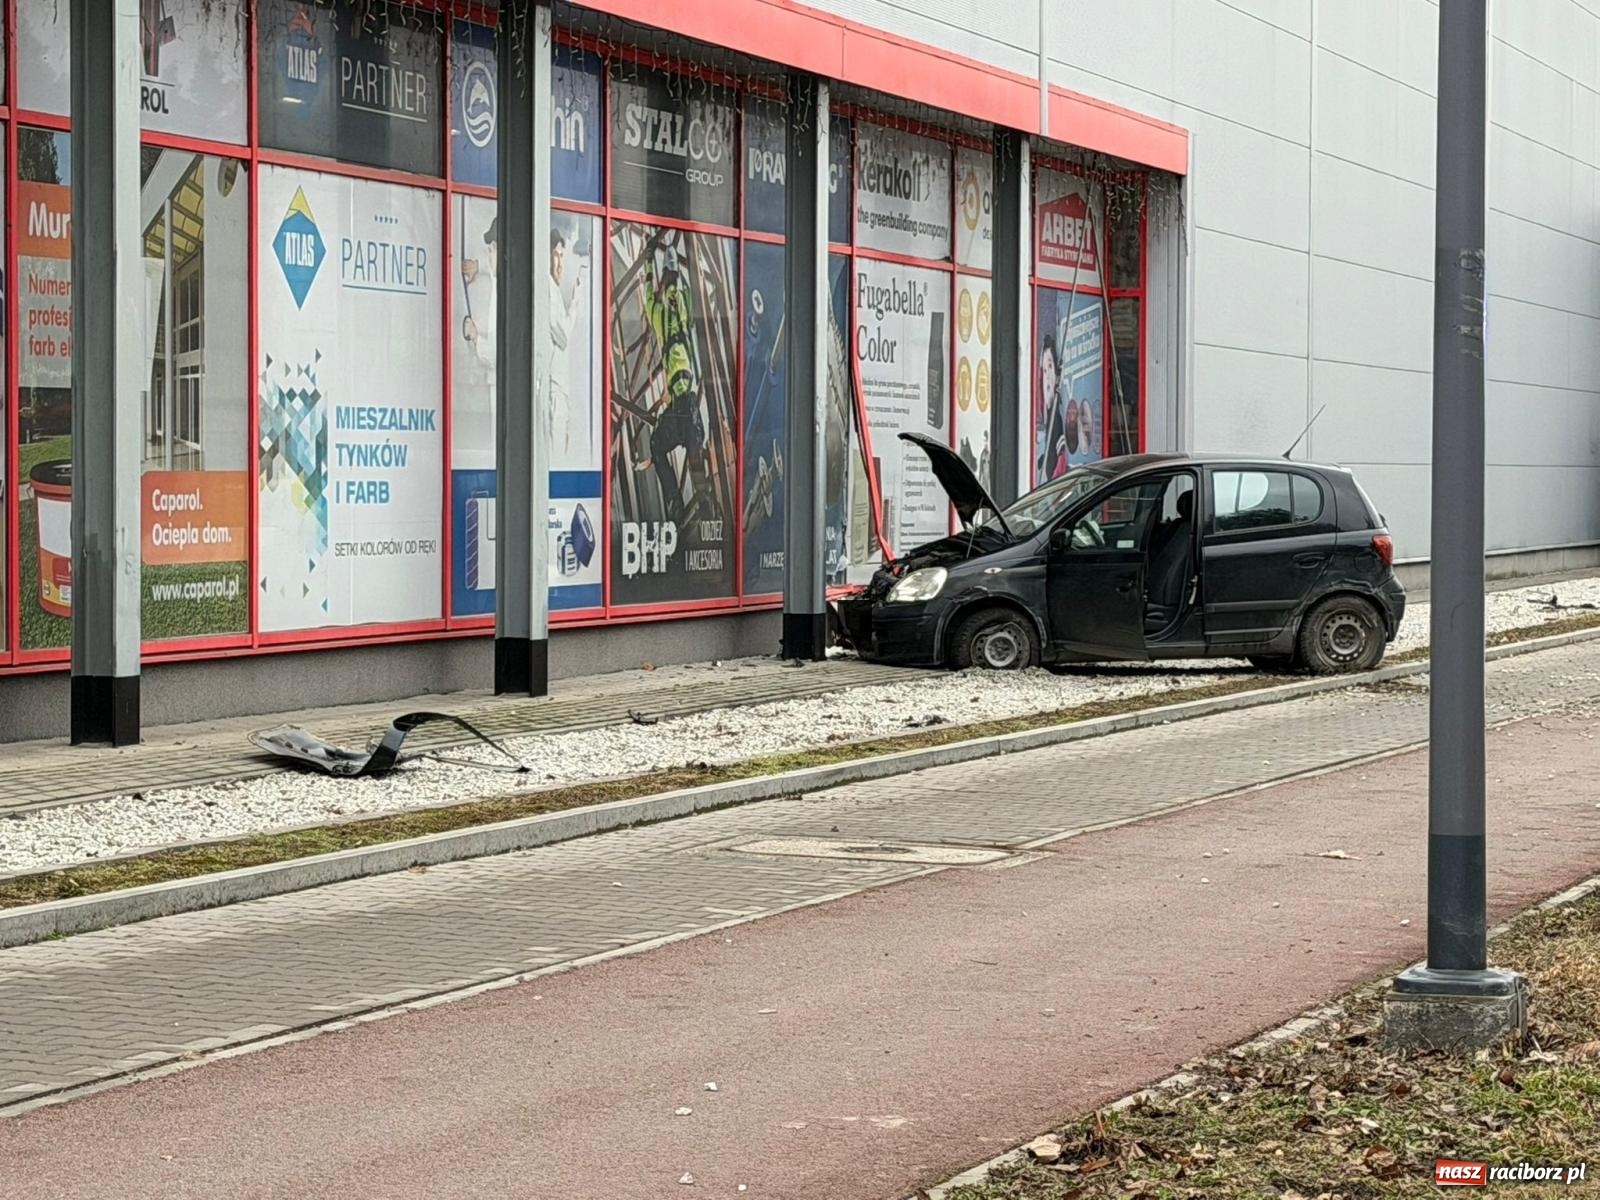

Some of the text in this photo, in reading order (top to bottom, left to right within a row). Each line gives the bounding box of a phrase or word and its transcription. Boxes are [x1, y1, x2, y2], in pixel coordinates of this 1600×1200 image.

[287, 45, 428, 115] ATLAS PARTNER
[623, 103, 723, 163] STALCO
[685, 168, 724, 187] GROUP
[28, 201, 71, 239] Mur
[857, 204, 948, 242] the greenbuilding company
[284, 231, 428, 288] ATLAS PARTNER
[29, 335, 57, 358] farb
[857, 325, 897, 364] Color
[335, 406, 436, 432] MIESZALNIK
[335, 439, 408, 468] TYNKÓW
[152, 488, 204, 518] Caparol.
[335, 481, 391, 504] I FARB
[152, 520, 233, 551] Ociepla dom.
[335, 542, 358, 558] SETKI
[360, 538, 403, 556] KOLORÓW
[404, 540, 417, 554] OD
[622, 520, 678, 579] BHP
[152, 575, 240, 603] www.caparol.pl
